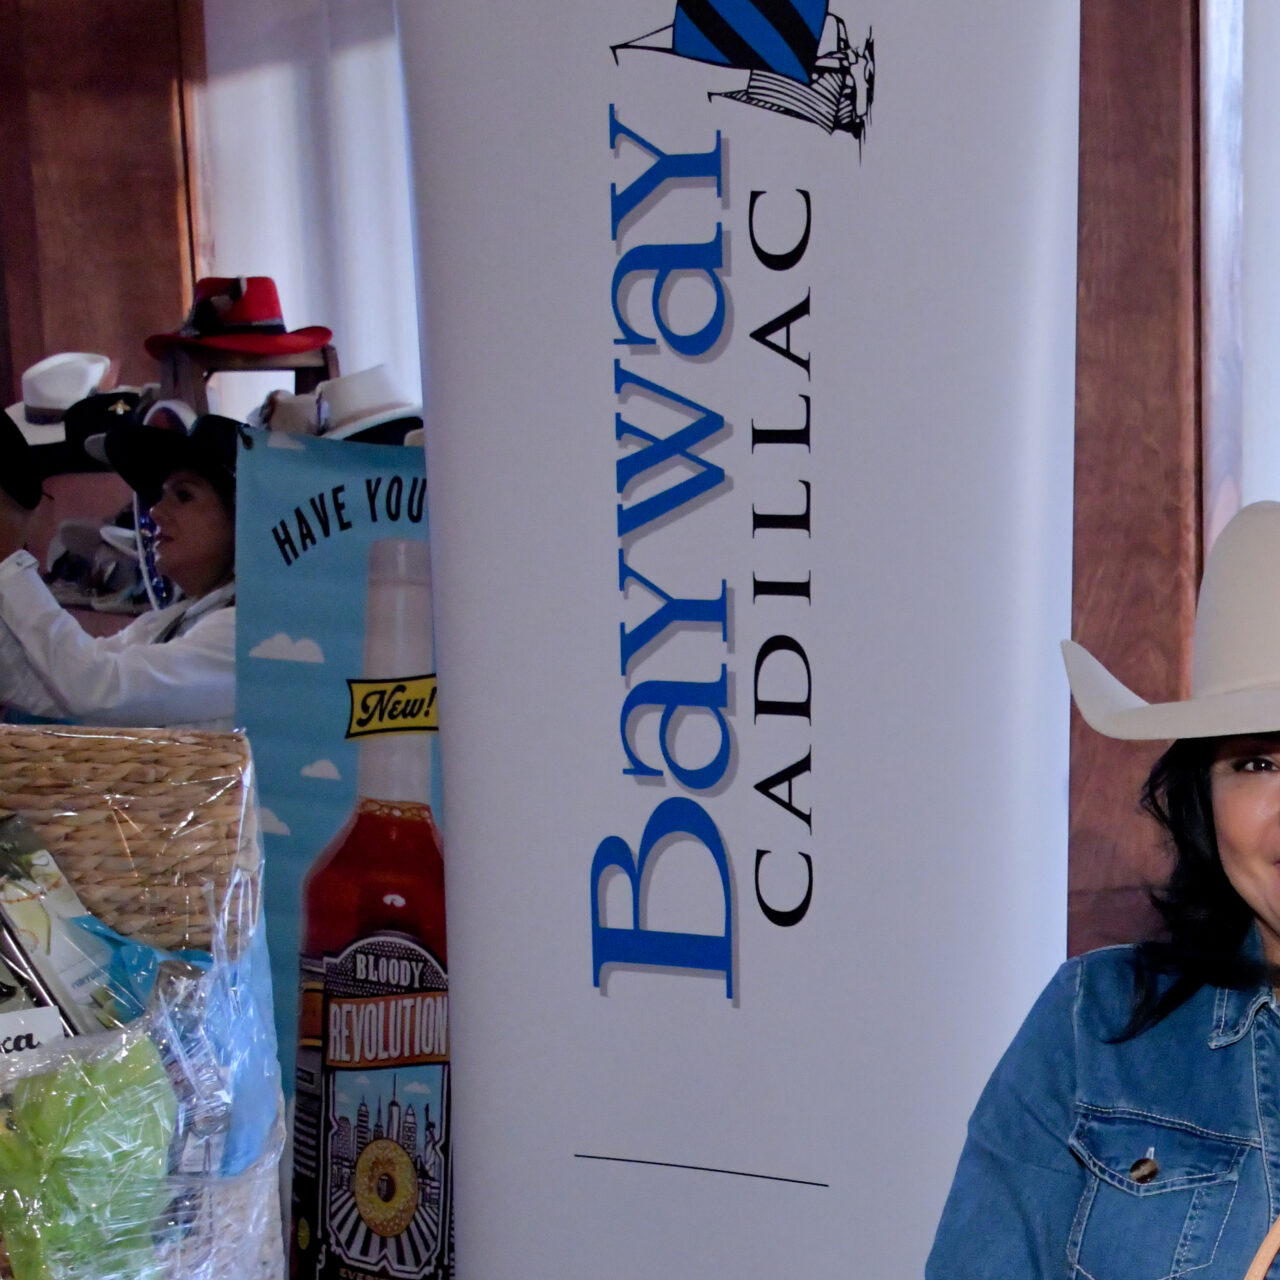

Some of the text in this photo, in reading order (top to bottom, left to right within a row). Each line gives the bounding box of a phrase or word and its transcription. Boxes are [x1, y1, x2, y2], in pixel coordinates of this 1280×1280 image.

[271, 475, 427, 567] HAVE YOU
[748, 188, 814, 929] CADILLAC
[355, 684, 438, 728] New!
[355, 952, 425, 989] BLOODY
[328, 995, 449, 1064] REVOLUTION
